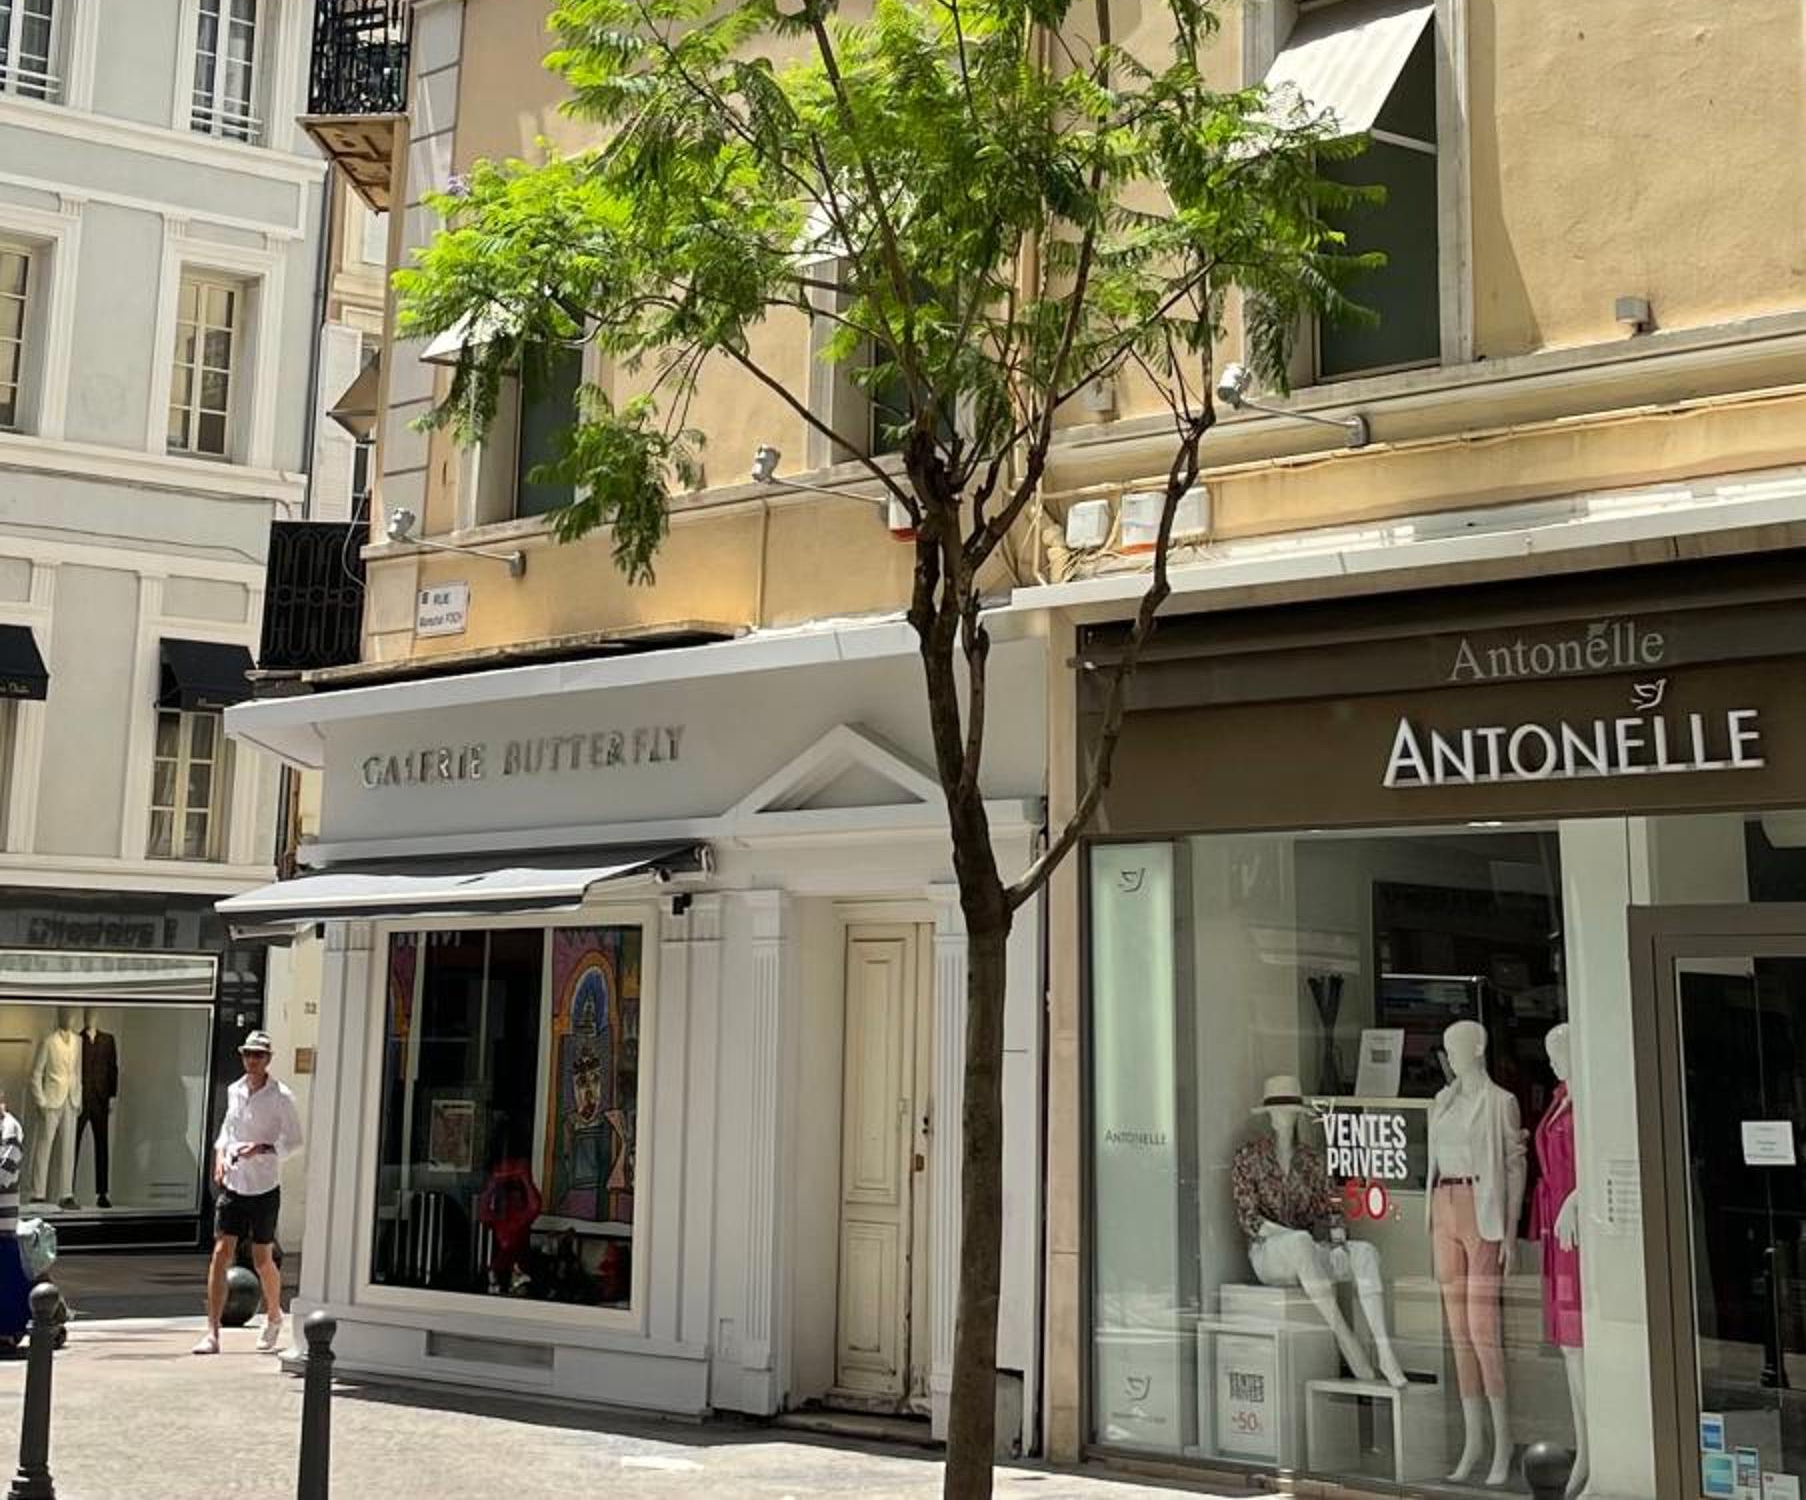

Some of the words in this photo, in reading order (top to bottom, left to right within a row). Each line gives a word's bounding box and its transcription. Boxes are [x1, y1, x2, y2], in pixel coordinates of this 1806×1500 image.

[503, 724, 684, 776] BUTTERFLY
[1382, 708, 1765, 789] ANTONELLE
[1322, 1112, 1407, 1149] VENTES
[1327, 1146, 1408, 1180] PRIVEES
